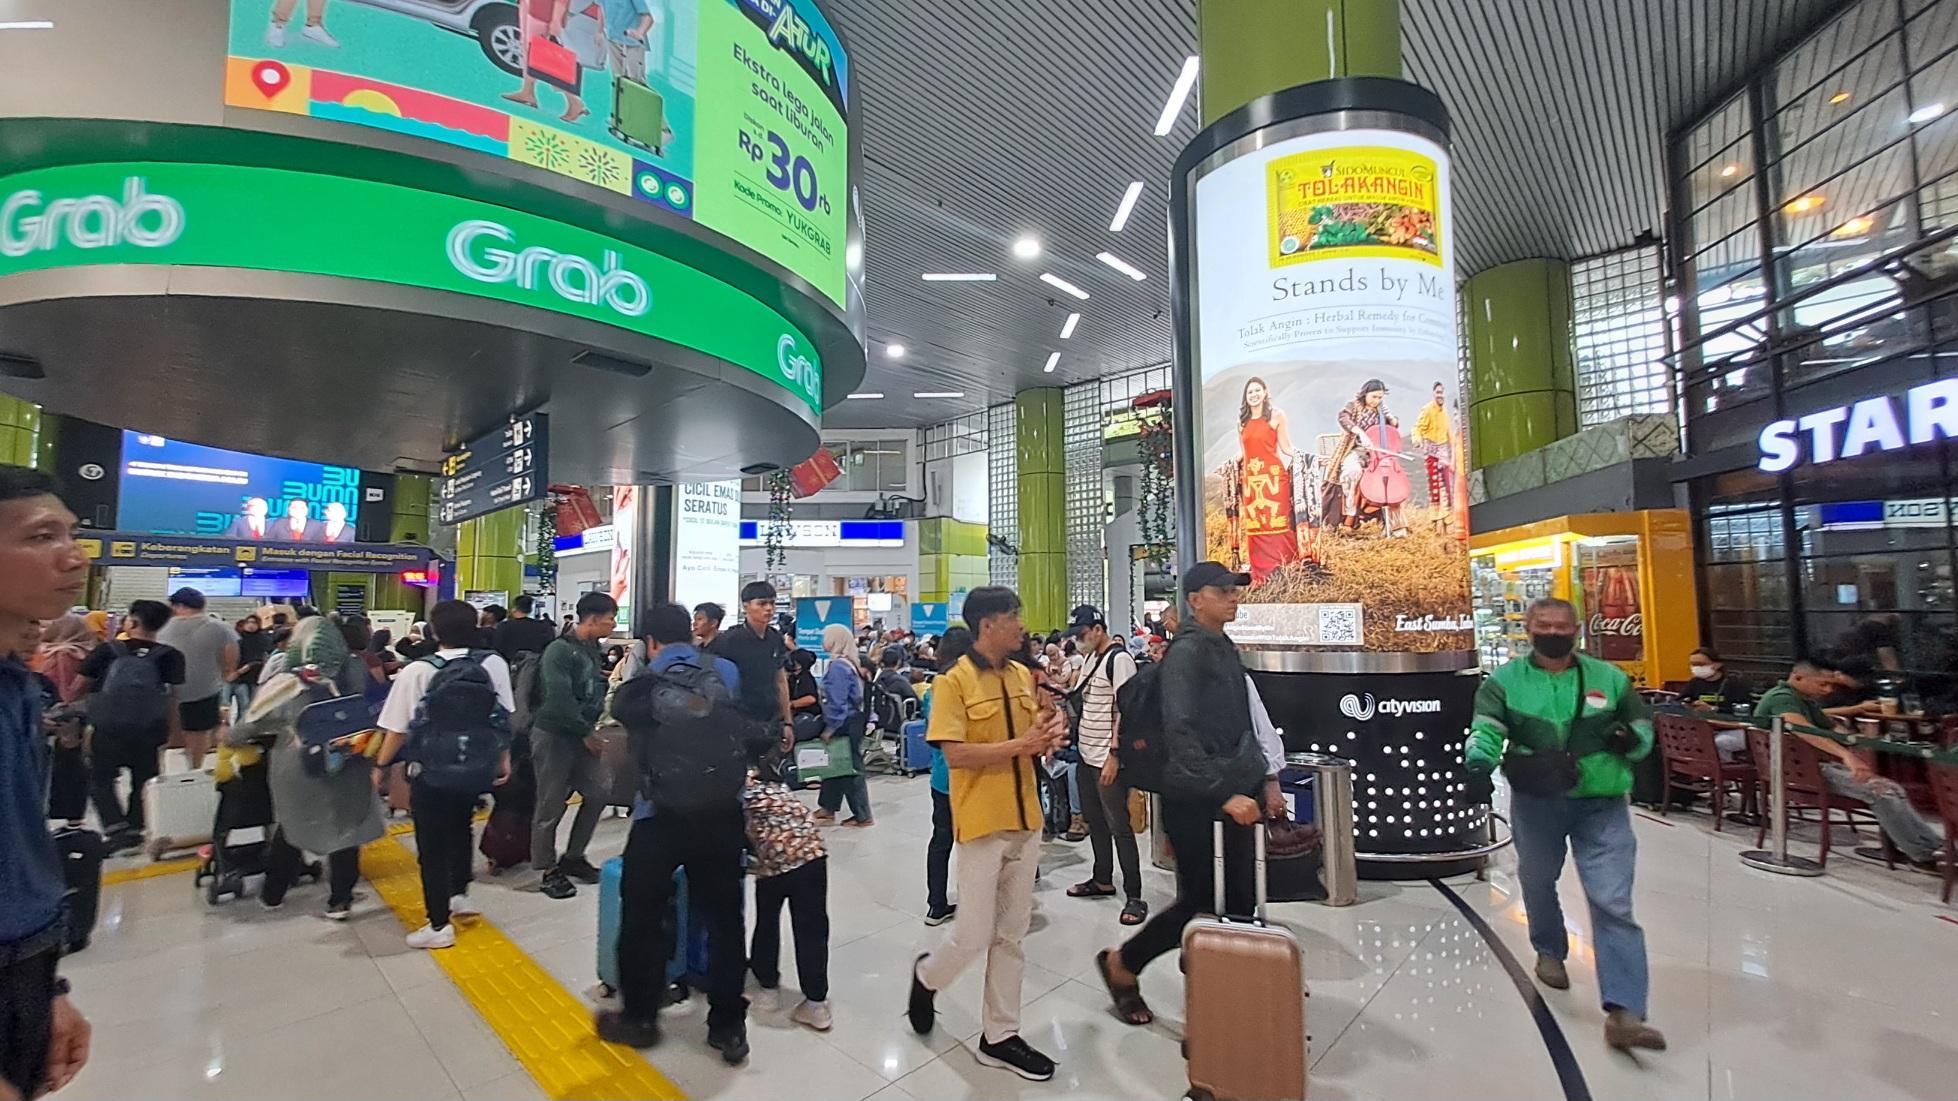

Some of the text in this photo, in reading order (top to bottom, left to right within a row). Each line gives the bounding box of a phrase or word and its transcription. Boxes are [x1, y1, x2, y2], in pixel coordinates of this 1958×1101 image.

[733, 43, 834, 147] Ekstra lega jalan
[752, 82, 824, 154] saat liburan
[738, 128, 831, 216] Rp 30 rb
[0, 176, 186, 257] Grab
[734, 180, 755, 200] Kode
[786, 210, 832, 255] YUKGRAB
[445, 219, 654, 317] Grab
[1273, 268, 1444, 301] Stands by Me
[1239, 322, 1265, 339] Tolak
[1270, 319, 1302, 332] Angin
[1314, 310, 1354, 325] Herbal
[1358, 309, 1399, 325] Remedy
[684, 482, 711, 497] CICIL
[684, 499, 728, 515] SERATUS
[140, 542, 231, 554] Keberangkatan
[262, 547, 297, 556] Masuk
[298, 549, 335, 559] dengan
[336, 550, 364, 558] Facial
[365, 551, 418, 561] Recognition
[1395, 614, 1423, 631] East
[1378, 699, 1441, 717] cityvision
